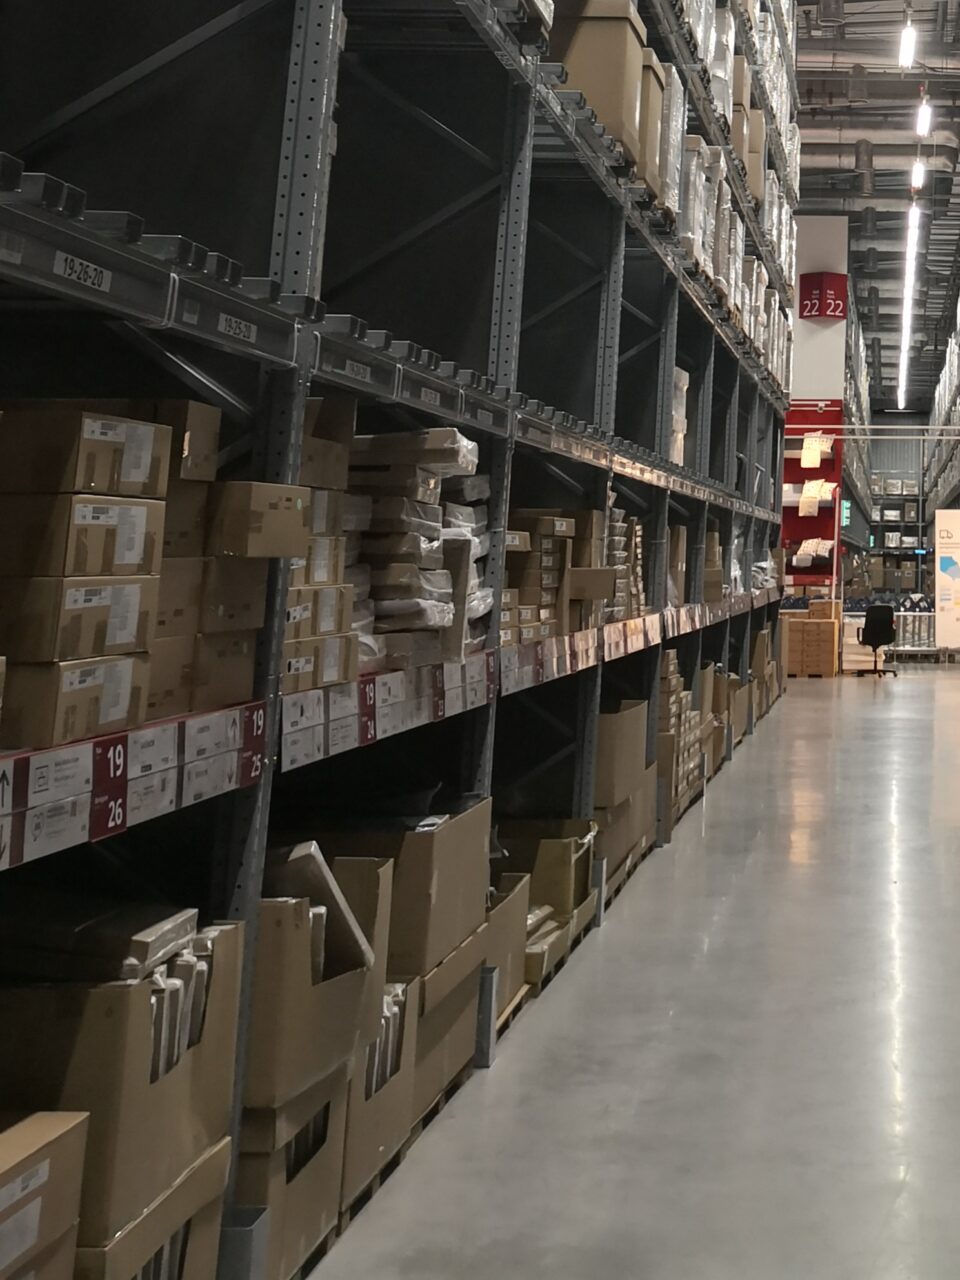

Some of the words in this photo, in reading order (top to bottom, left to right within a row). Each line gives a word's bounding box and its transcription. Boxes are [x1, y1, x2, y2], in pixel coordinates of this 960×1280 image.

[63, 256, 104, 288] 19-26-20
[802, 299, 820, 316] 22
[826, 299, 844, 316] 22
[225, 317, 252, 339] 19-25-20
[365, 683, 374, 705] 19
[252, 708, 264, 737] 19
[107, 744, 124, 778] 19
[250, 753, 262, 778] 25
[107, 798, 123, 829] 26
